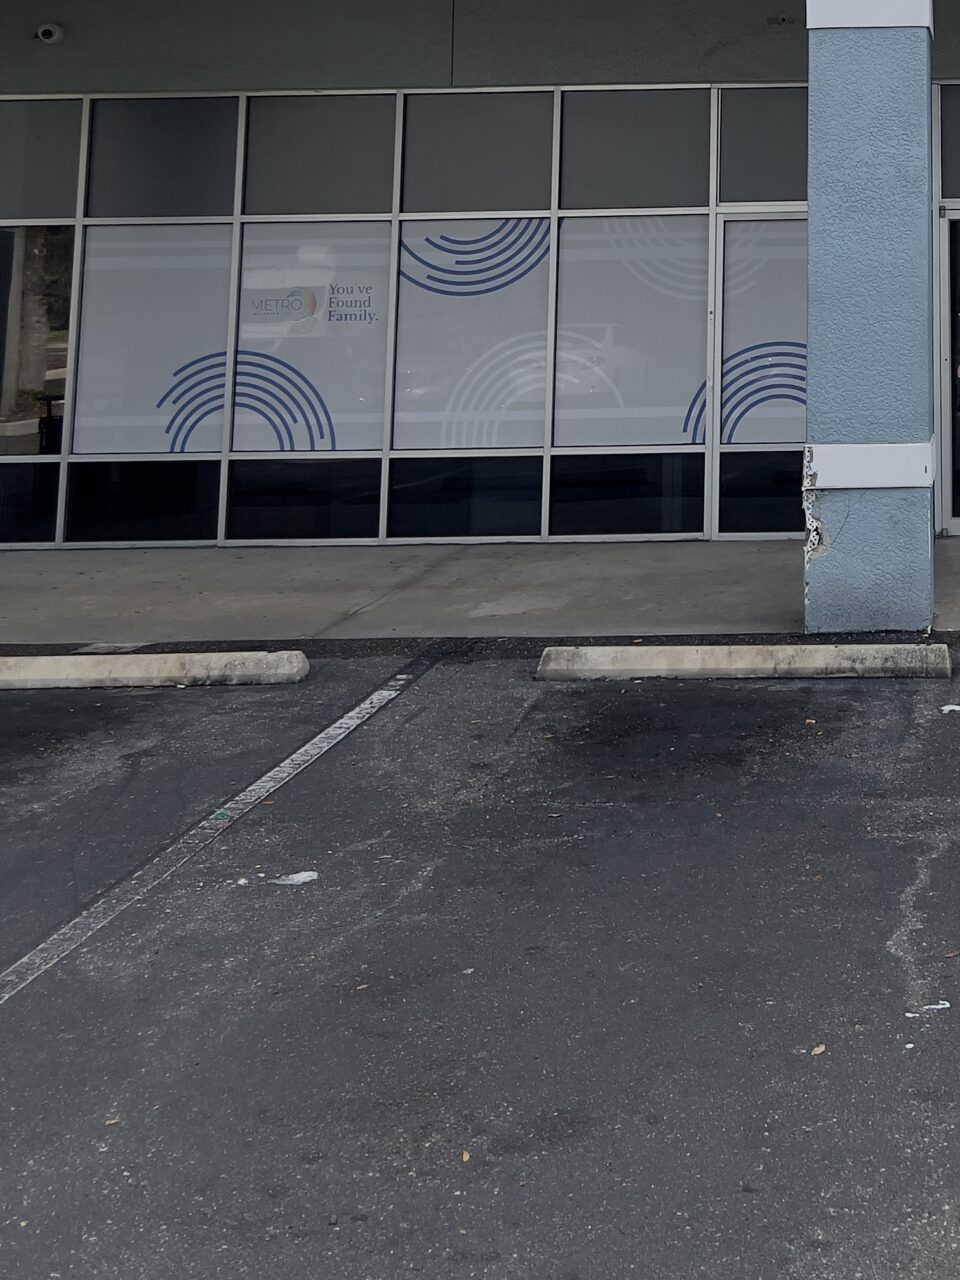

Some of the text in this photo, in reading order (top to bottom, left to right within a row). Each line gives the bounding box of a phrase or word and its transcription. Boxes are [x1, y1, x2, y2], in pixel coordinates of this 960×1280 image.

[329, 283, 373, 295] You've
[251, 299, 303, 311] METRO
[328, 295, 371, 308] Found
[327, 309, 379, 324] Family.
